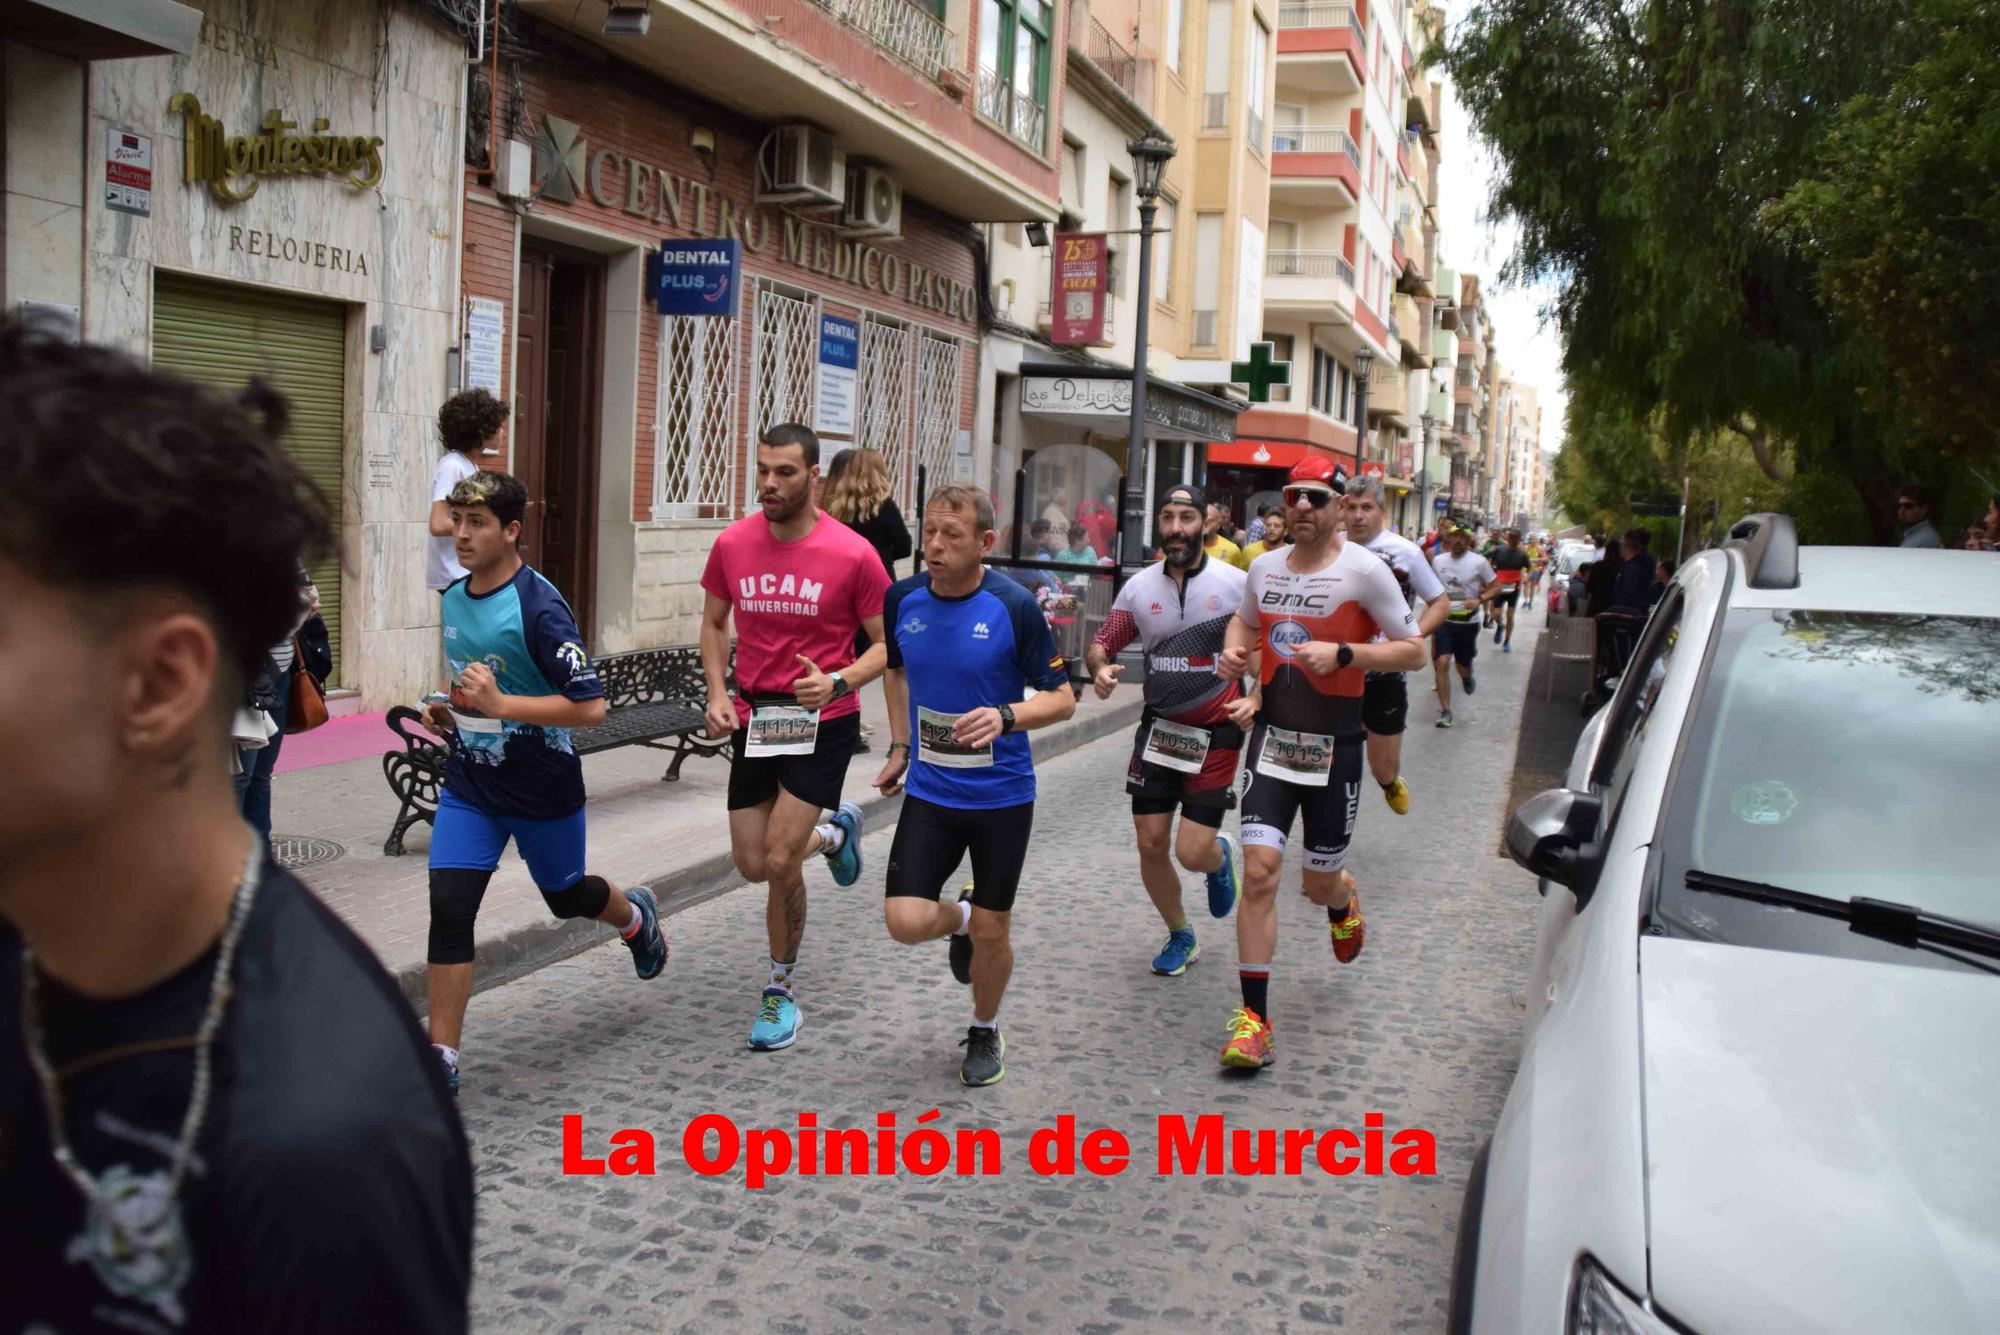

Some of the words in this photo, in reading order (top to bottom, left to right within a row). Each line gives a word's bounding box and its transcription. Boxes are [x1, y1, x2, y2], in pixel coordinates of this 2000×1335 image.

[169, 92, 385, 203] Montesinos
[590, 147, 770, 253] CENTRO
[780, 213, 900, 297] MEDICO
[908, 261, 978, 322] PASEO
[229, 225, 368, 276] RELOJERIA
[663, 250, 731, 264] DENTAL
[661, 274, 705, 288] PLUS
[823, 320, 856, 340] DENTAL
[823, 341, 845, 356] PLUS
[1023, 379, 1048, 408] Las
[1053, 378, 1132, 403] Delicias
[739, 573, 823, 603] UCAM
[740, 599, 819, 616] UNIVERSIDAD
[1261, 590, 1330, 609] BMC
[758, 718, 810, 735] 1117
[1159, 731, 1201, 753] 1054
[1275, 742, 1323, 763] 1015
